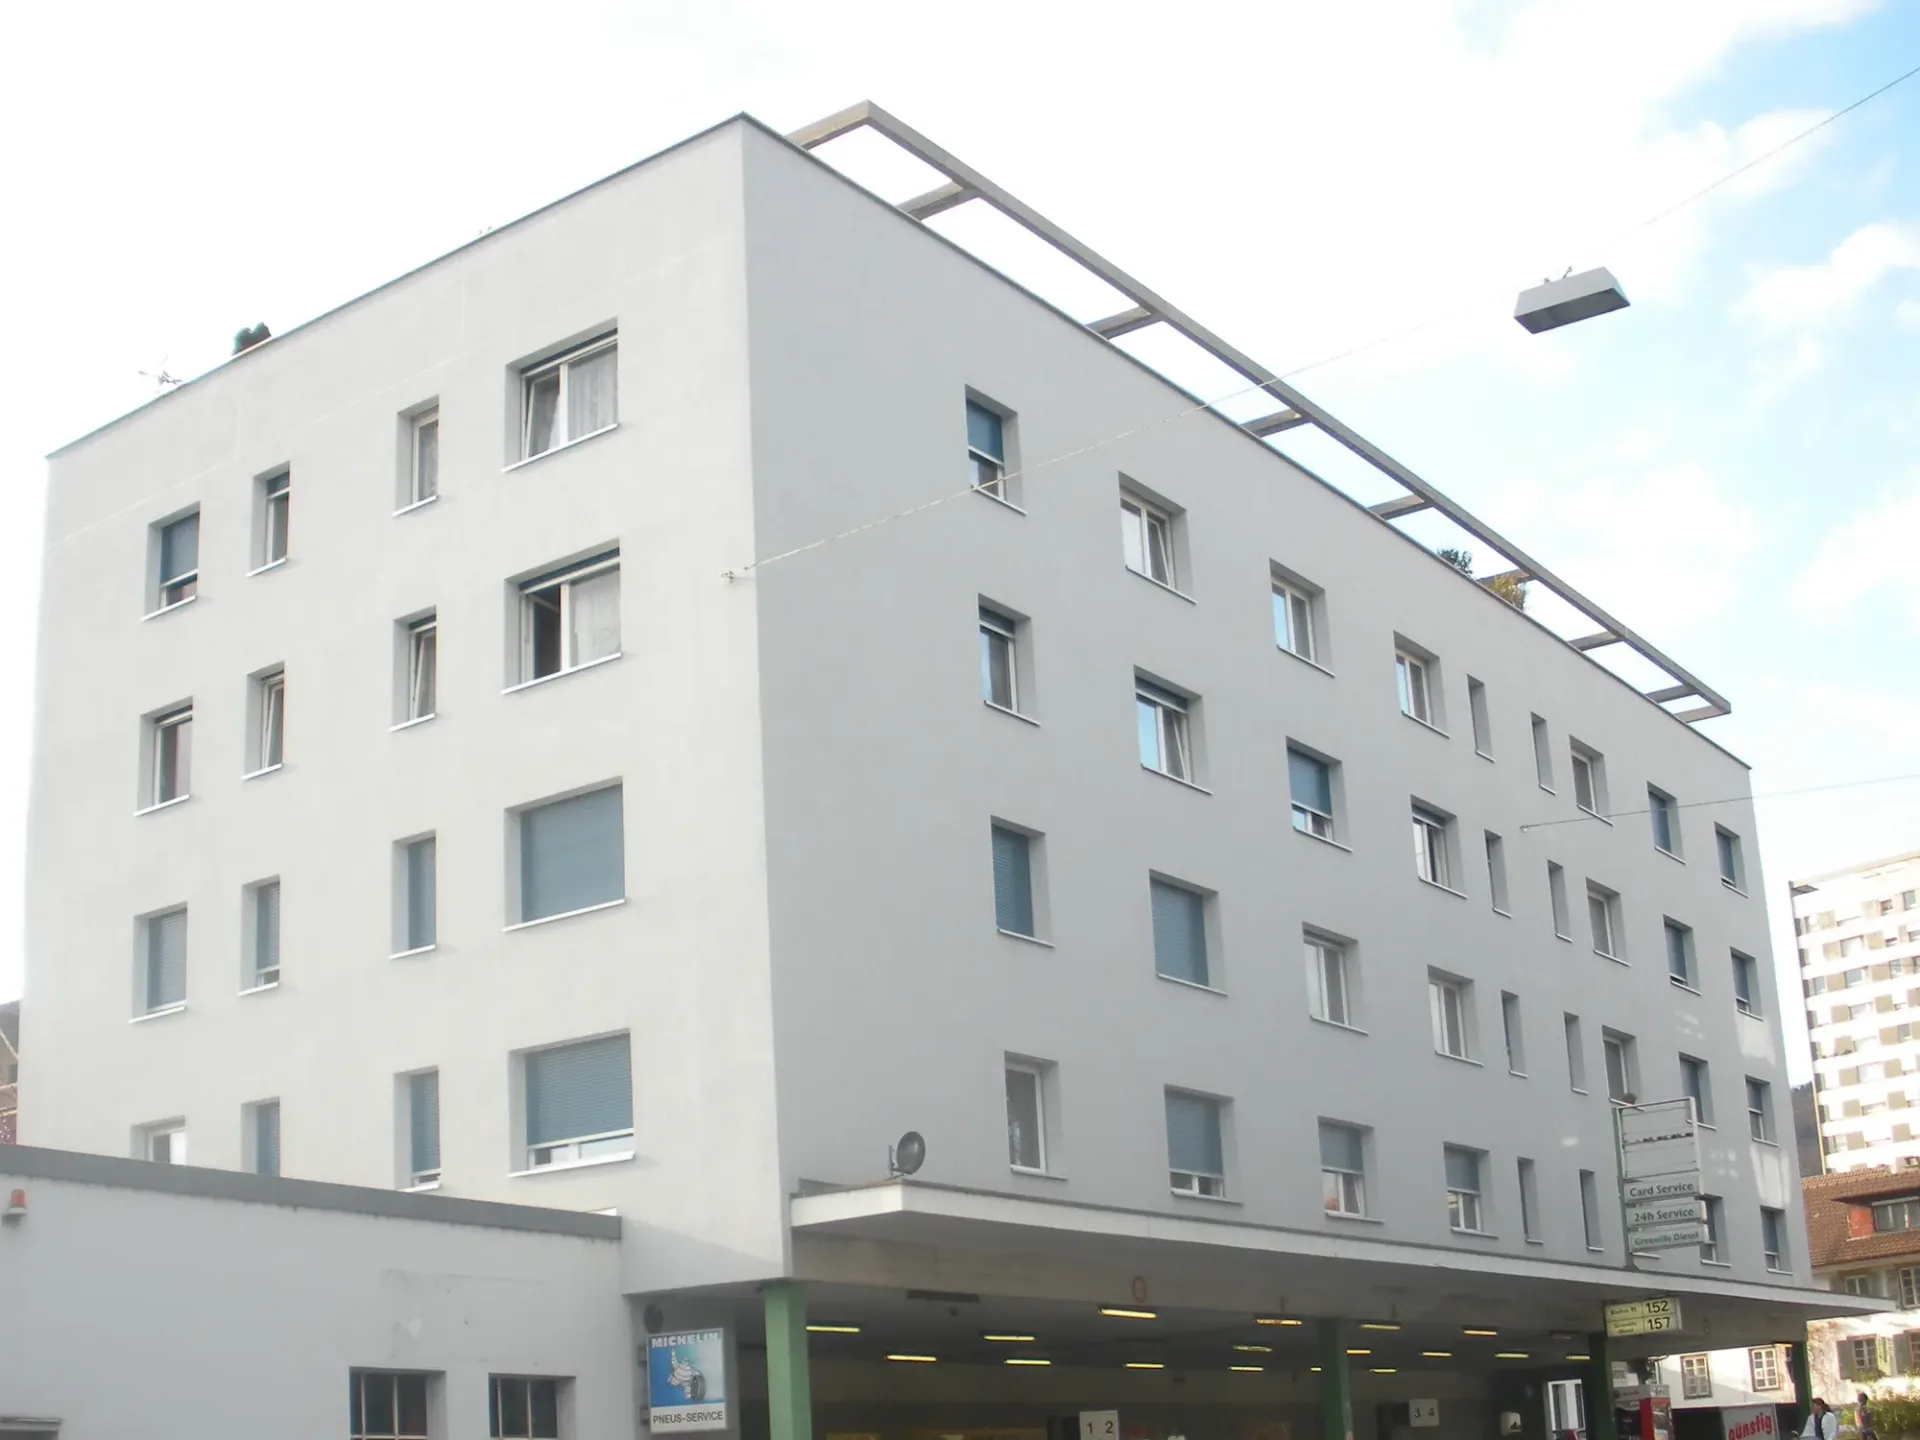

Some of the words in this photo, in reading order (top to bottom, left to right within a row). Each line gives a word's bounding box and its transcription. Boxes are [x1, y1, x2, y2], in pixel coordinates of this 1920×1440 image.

[1630, 1186, 1654, 1197] Card
[1656, 1182, 1693, 1194] Service
[1634, 1211, 1654, 1222] 24h
[1657, 1208, 1694, 1219] Service
[1673, 1231, 1699, 1241] Diesel
[651, 1332, 719, 1349] MICHELIN
[652, 1410, 724, 1425] PNEUS-SERVICE
[1413, 1407, 1421, 1418] 3
[1087, 1422, 1093, 1435] 1
[1105, 1420, 1114, 1434] 2
